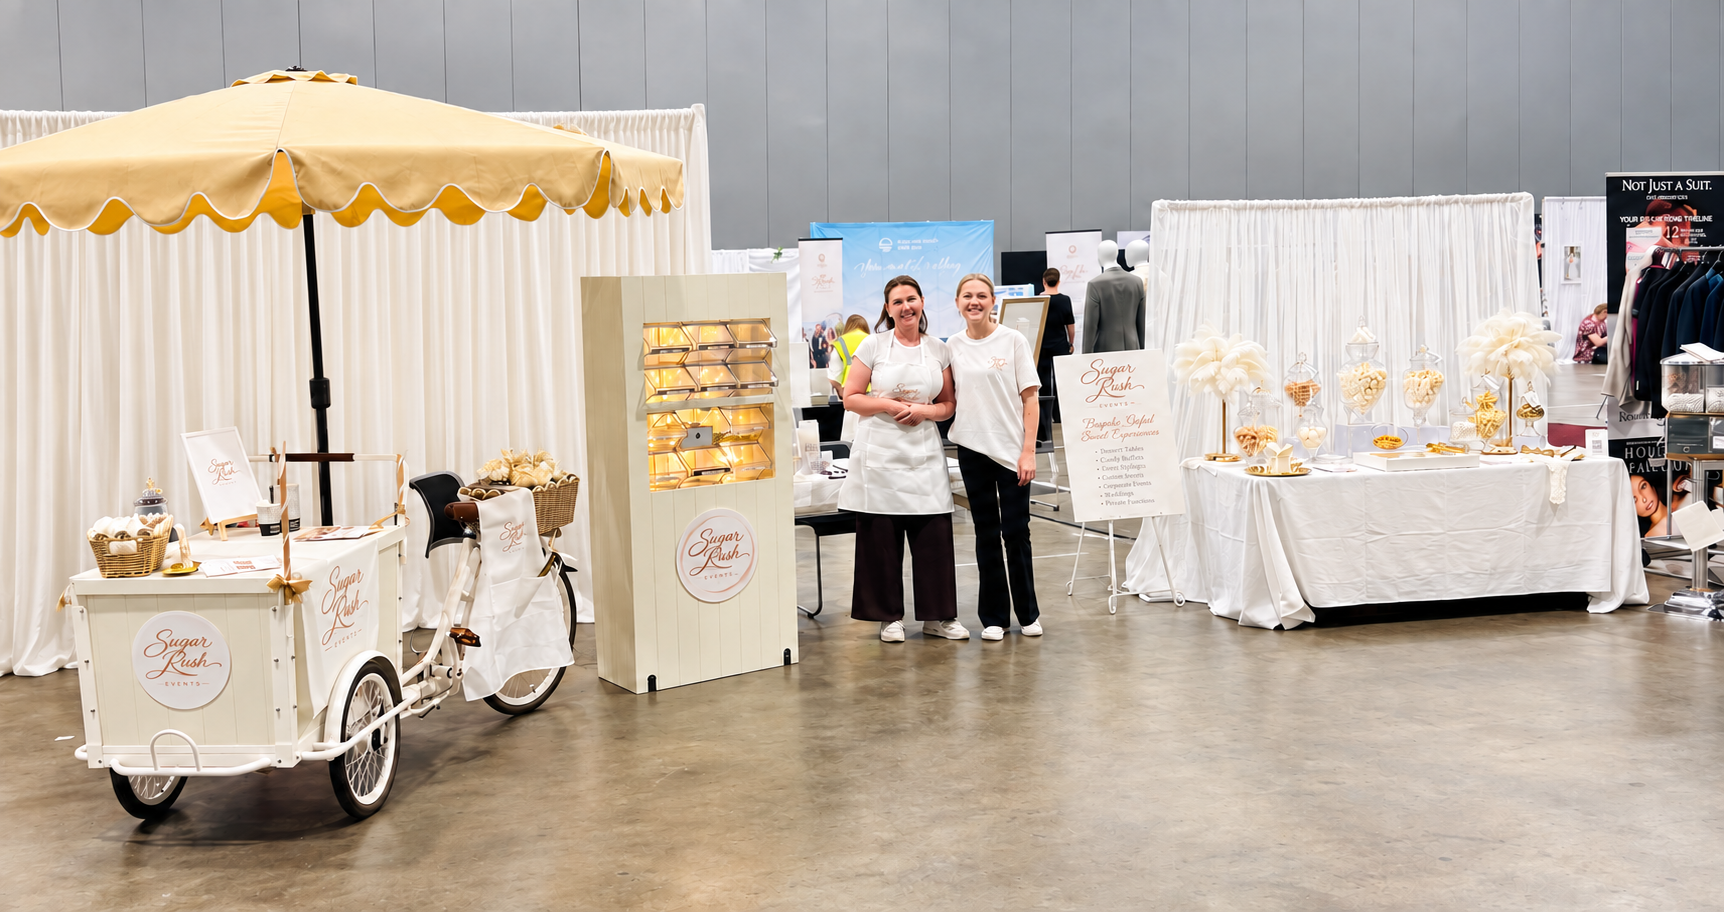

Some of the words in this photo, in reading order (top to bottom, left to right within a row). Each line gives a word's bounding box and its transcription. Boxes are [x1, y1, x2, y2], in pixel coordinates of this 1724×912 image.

[1666, 225, 1680, 238] 12
[1080, 358, 1136, 385] Sugar
[1085, 376, 1145, 403] Rush
[688, 527, 744, 557] Sugar
[689, 543, 750, 576] Rush
[321, 565, 364, 615] Sugar
[322, 590, 369, 646] Rush
[144, 628, 213, 658] Sugar
[145, 649, 222, 679] Rush
